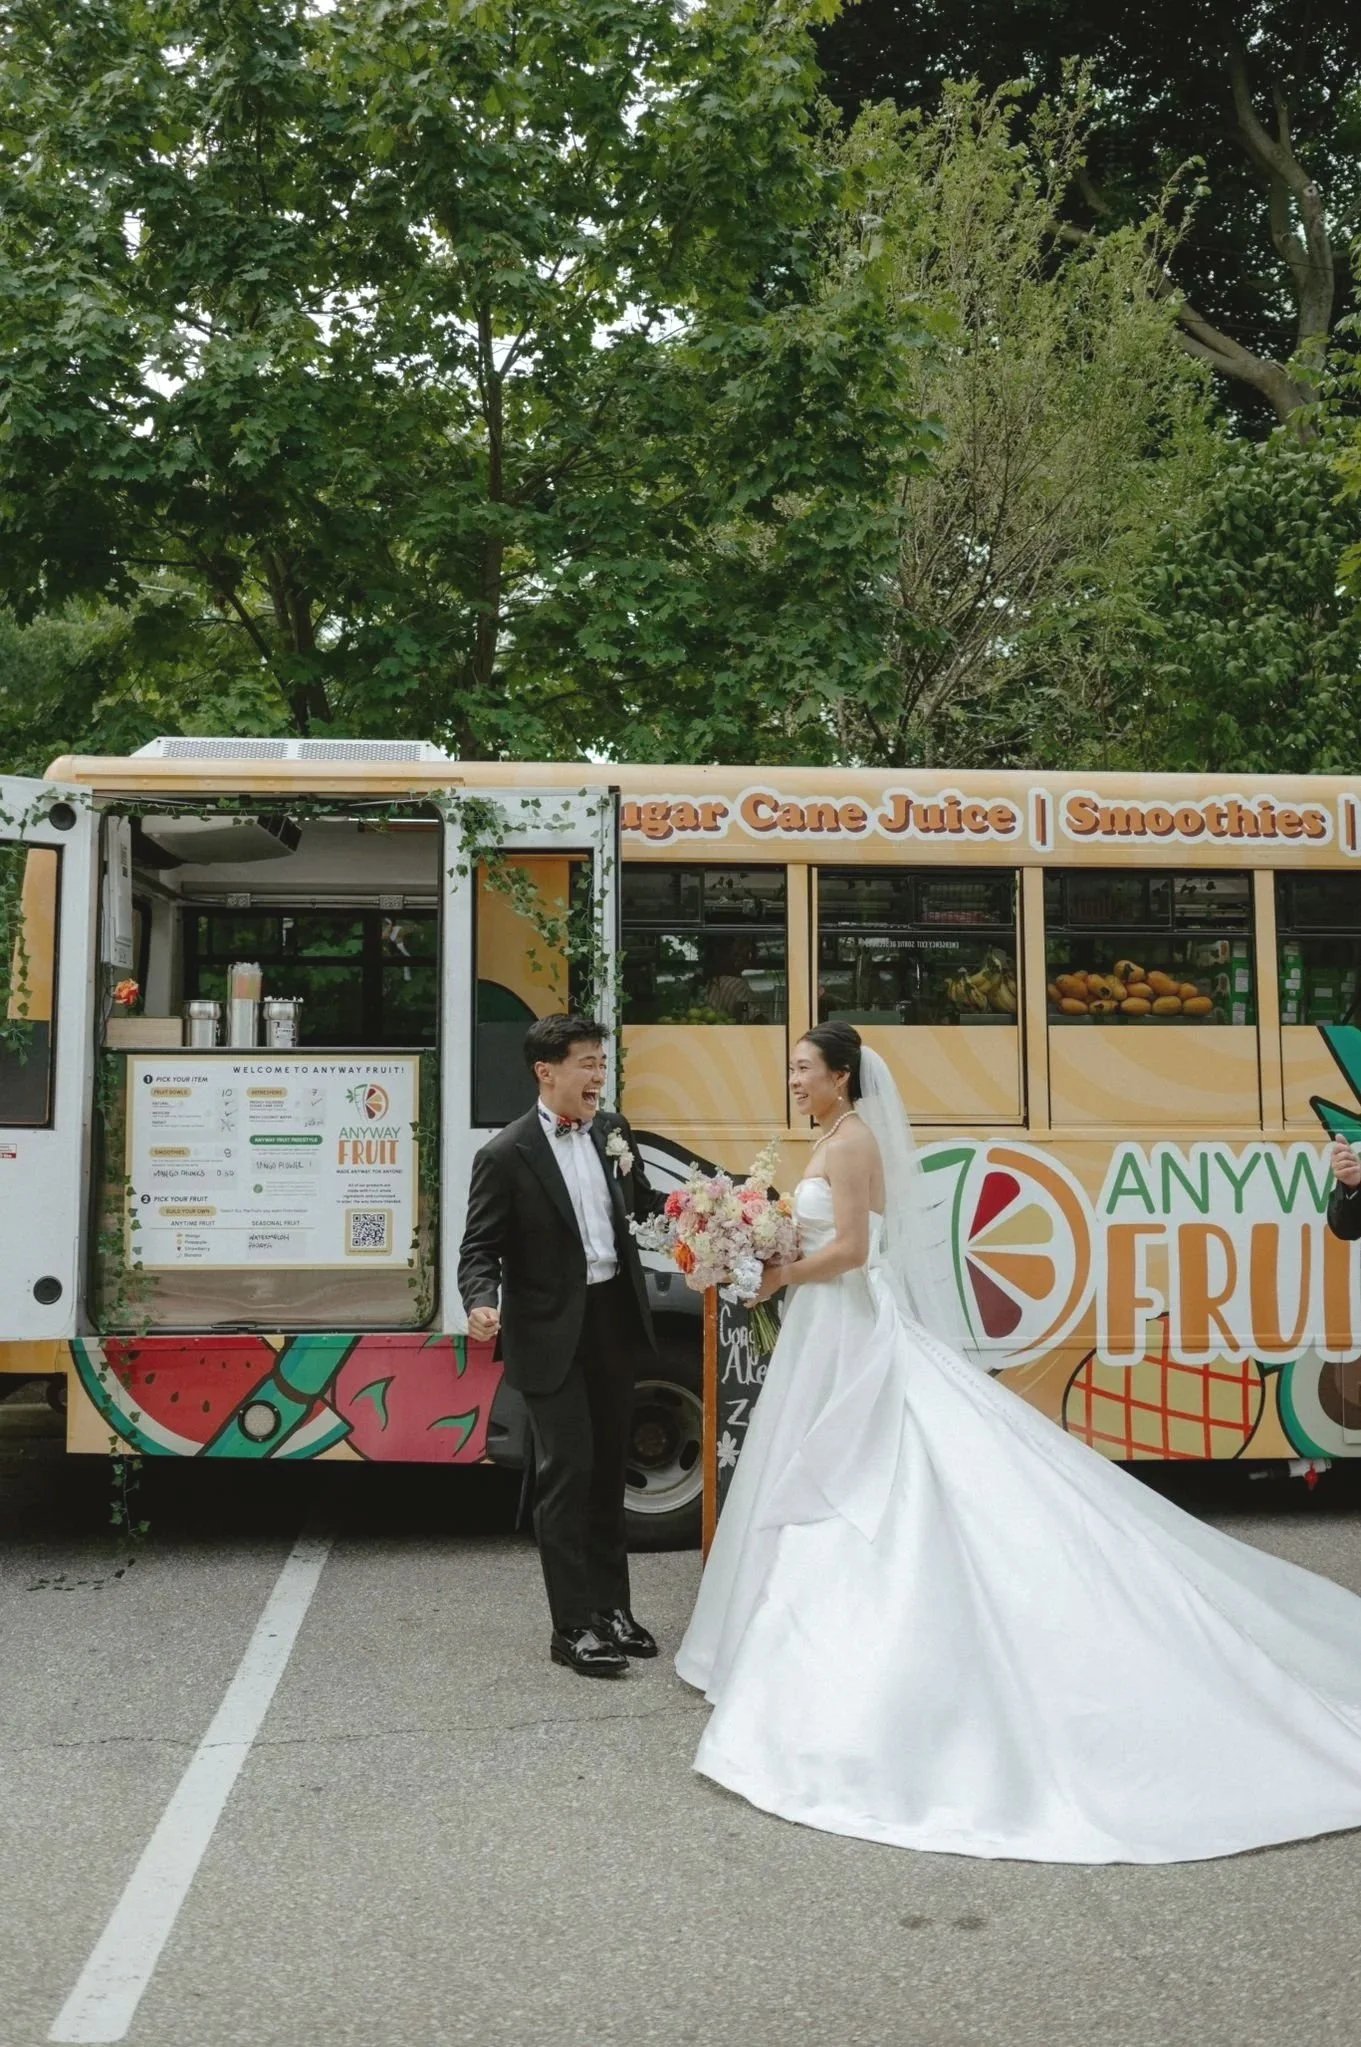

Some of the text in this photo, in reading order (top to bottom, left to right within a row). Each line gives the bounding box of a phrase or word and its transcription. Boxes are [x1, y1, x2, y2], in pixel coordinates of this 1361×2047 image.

[621, 801, 729, 840] ugar
[740, 792, 868, 833] Cane
[877, 793, 1017, 833] Juice
[1065, 796, 1327, 839] Smoothies
[233, 1066, 404, 1074] WELCOME TO ANYWAY FRUIT!
[339, 1127, 401, 1139] ANYWAY
[338, 1140, 399, 1165] FRUIT
[1106, 1151, 1336, 1214] ANYW
[1107, 1223, 1354, 1356] FRUI
